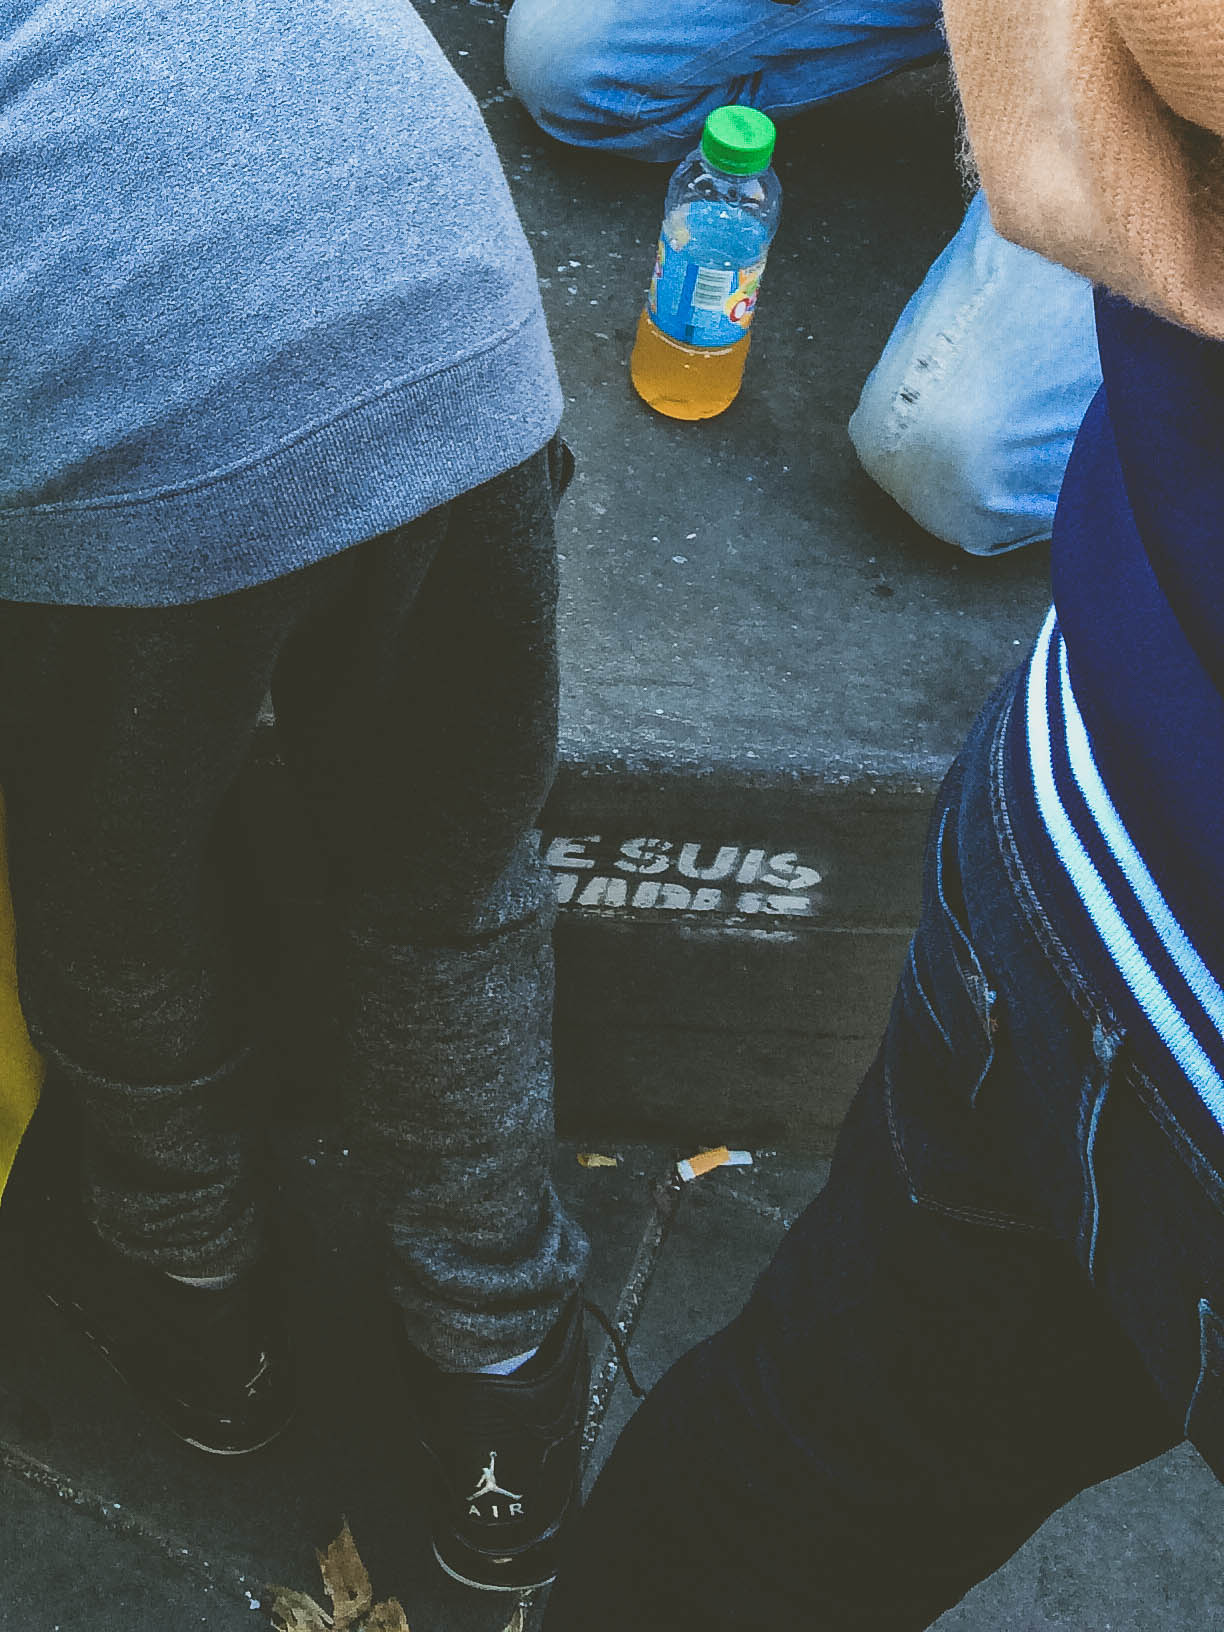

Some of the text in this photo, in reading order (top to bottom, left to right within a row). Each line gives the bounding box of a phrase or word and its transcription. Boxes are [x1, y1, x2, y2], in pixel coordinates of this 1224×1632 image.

[544, 835, 823, 890] E SUIS
[469, 1503, 524, 1518] AIR
